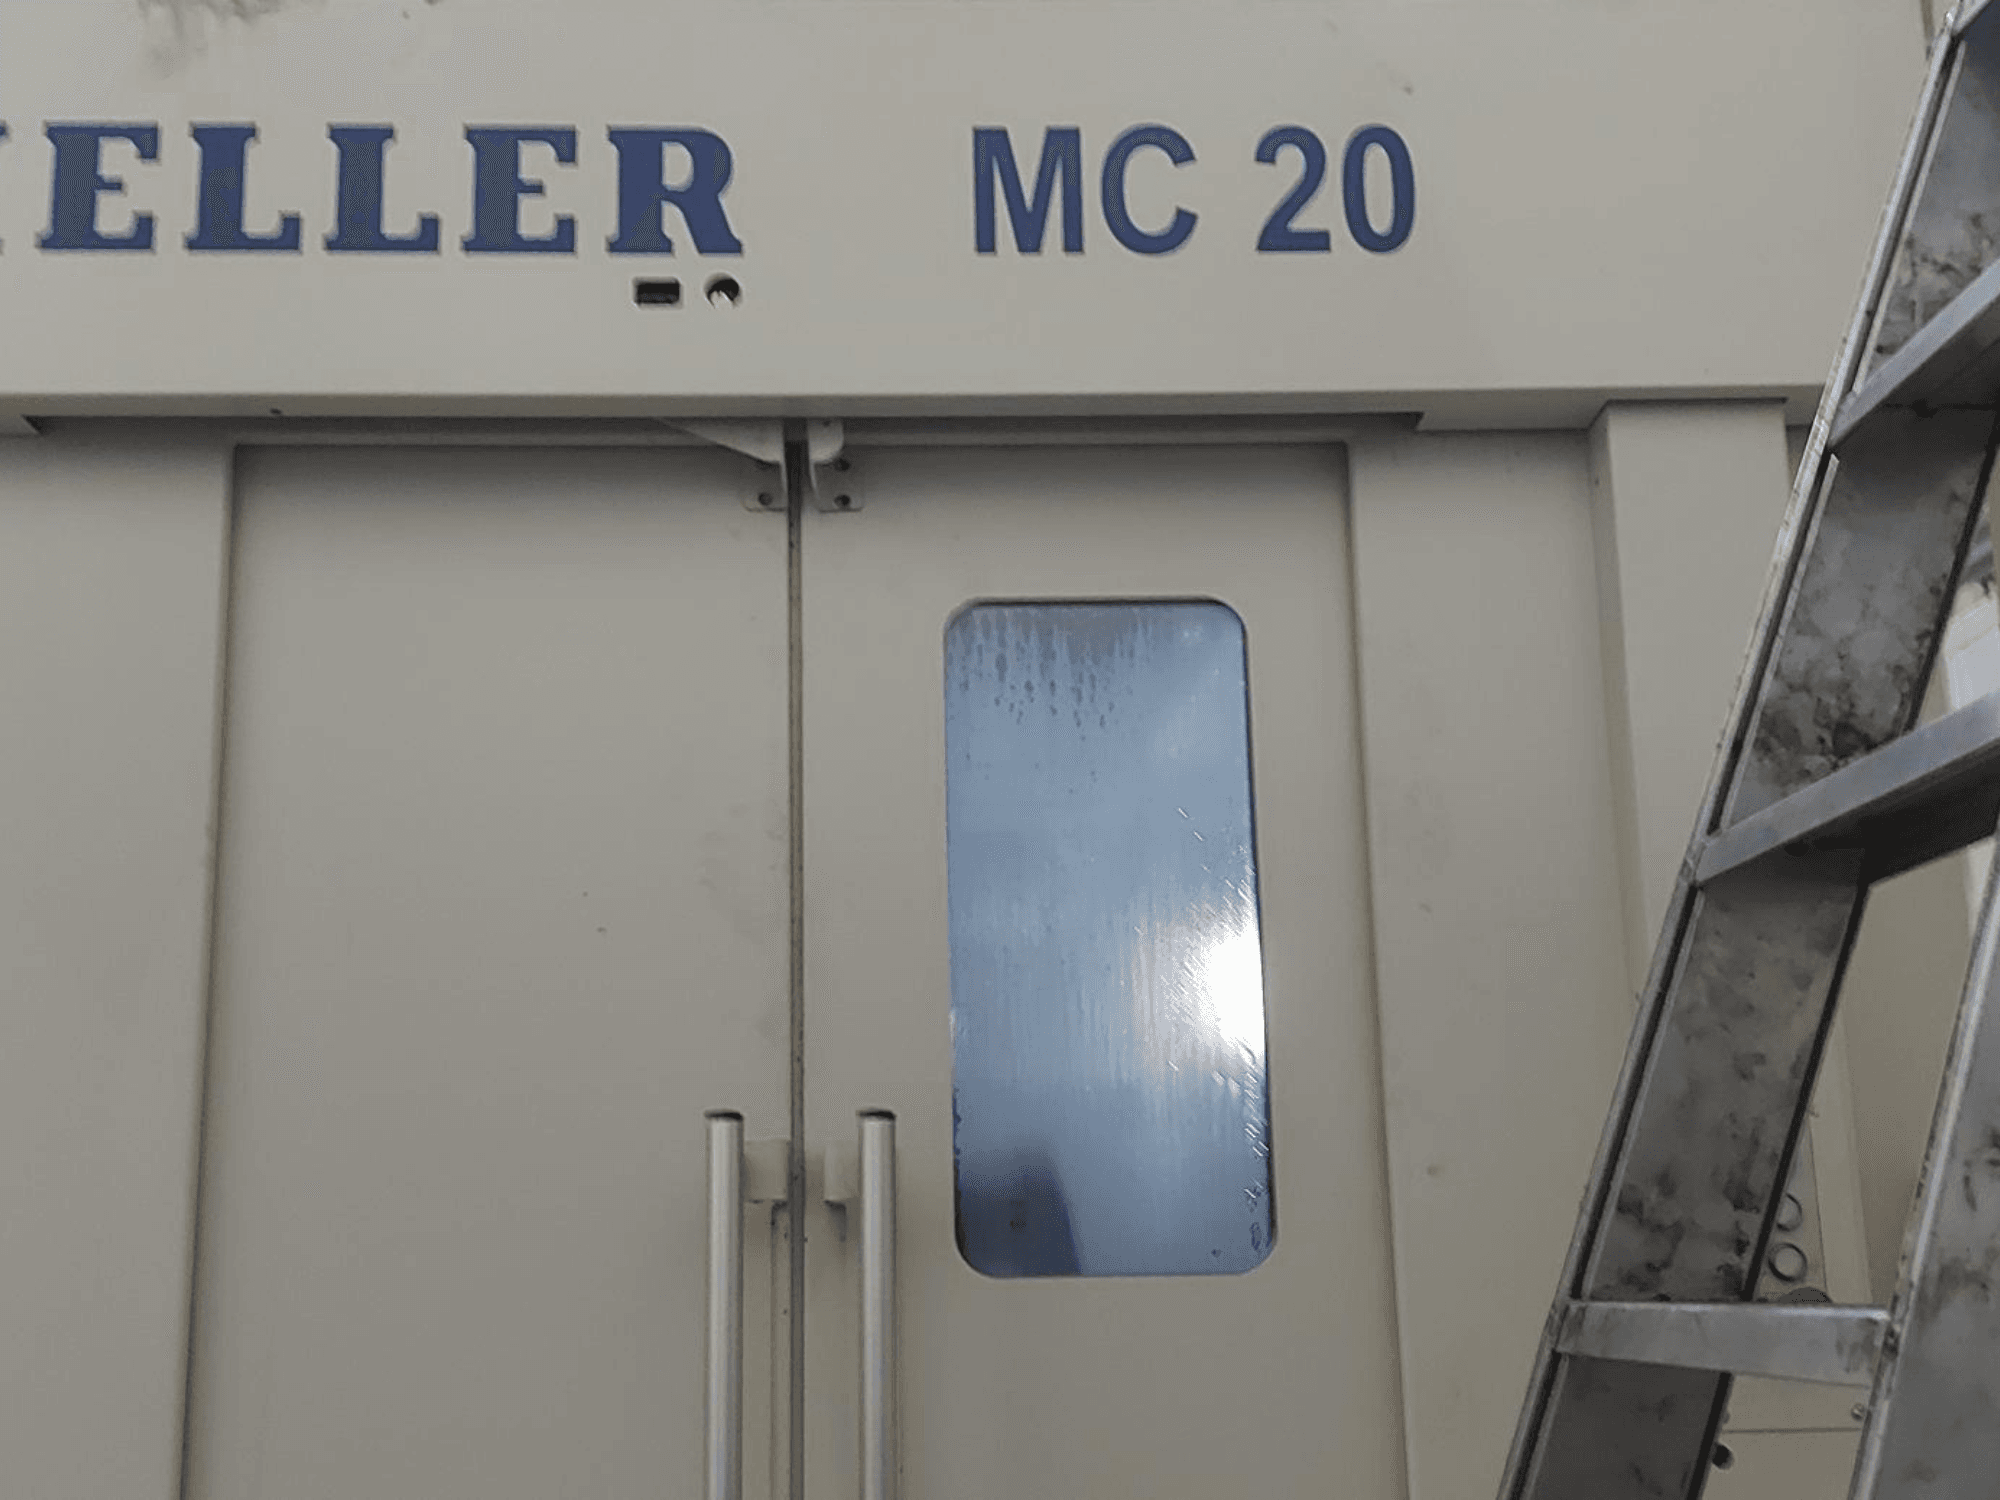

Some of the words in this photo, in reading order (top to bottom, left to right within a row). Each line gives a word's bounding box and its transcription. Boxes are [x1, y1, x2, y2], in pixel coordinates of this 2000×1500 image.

[0, 121, 742, 254] ELLER
[973, 123, 1198, 255] MC
[1254, 122, 1416, 254] 20
